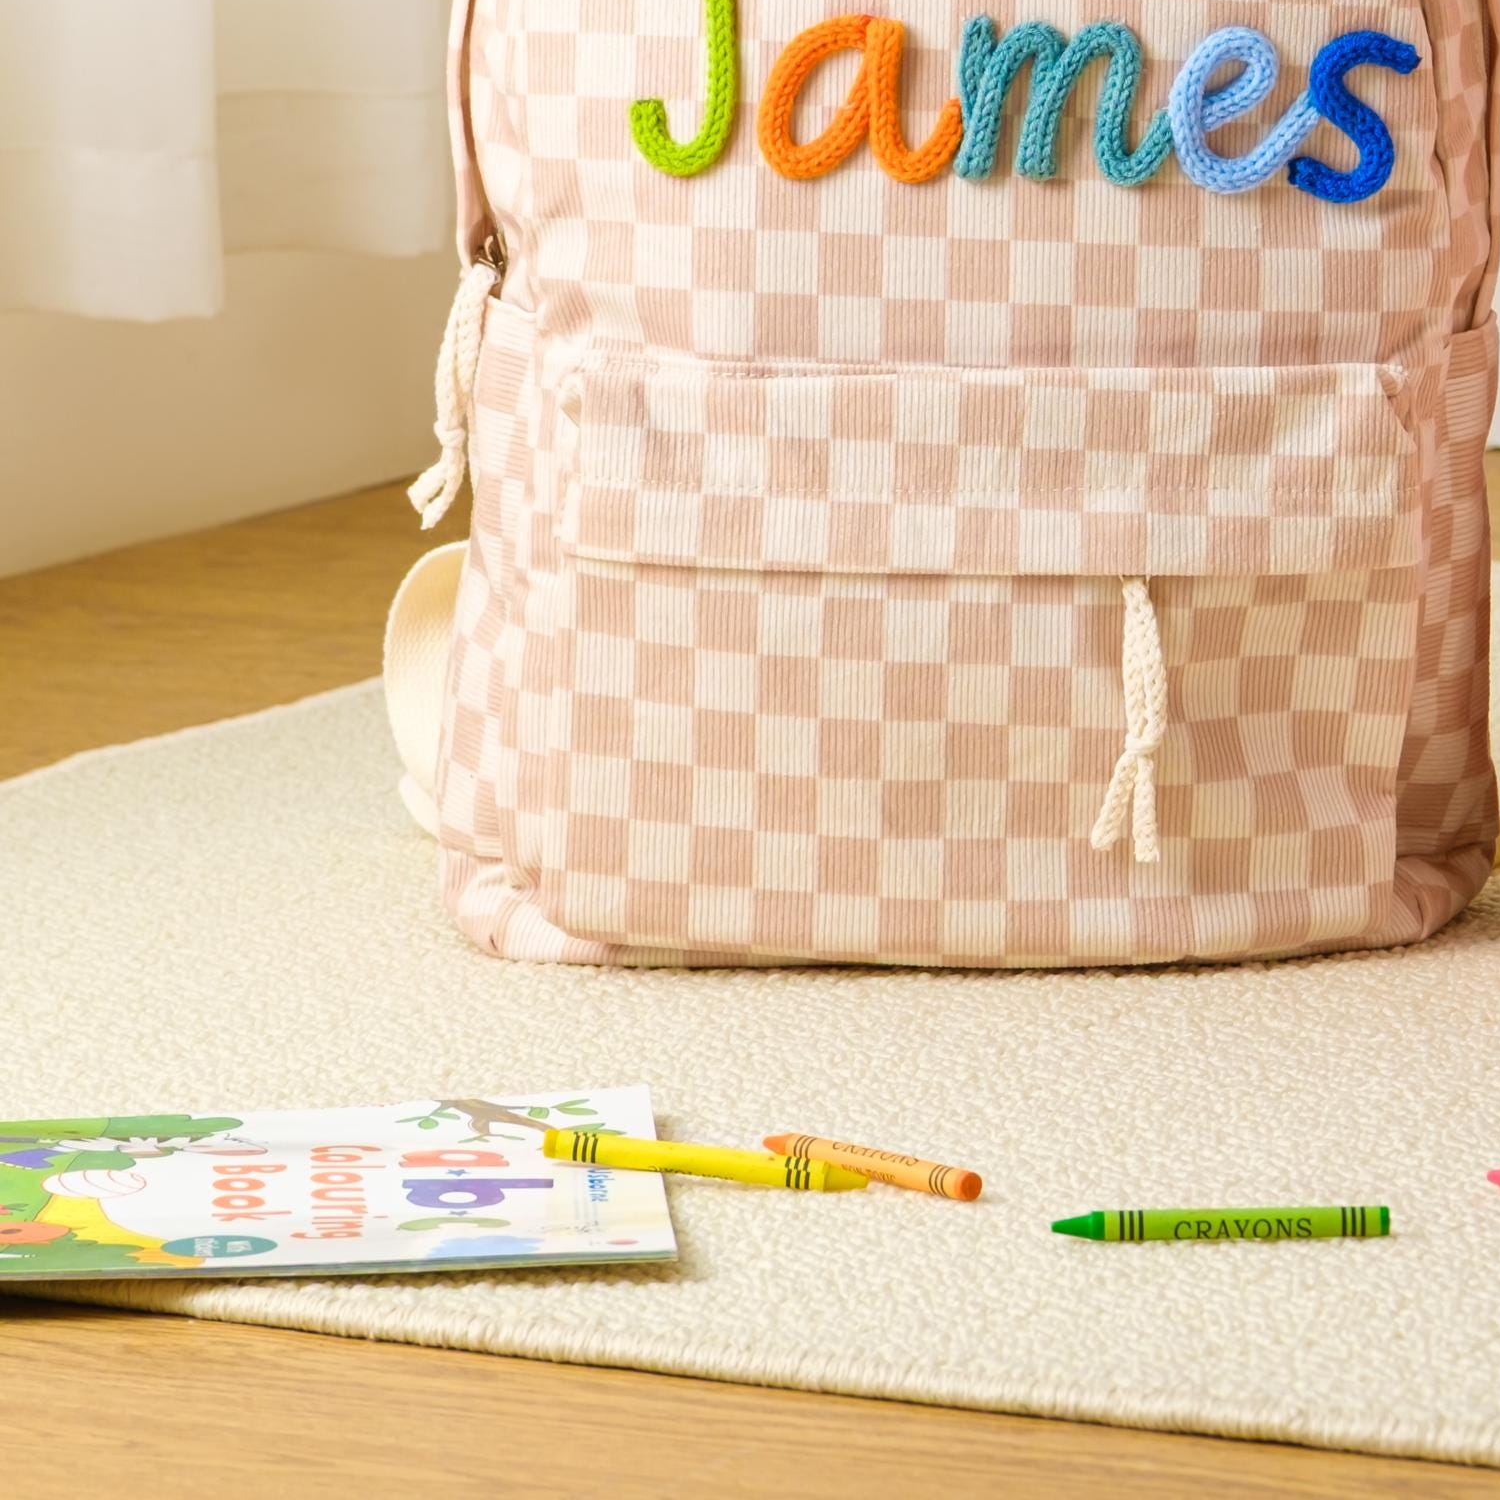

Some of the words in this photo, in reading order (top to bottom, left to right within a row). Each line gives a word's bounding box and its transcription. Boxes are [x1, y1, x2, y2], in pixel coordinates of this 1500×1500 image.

[211, 1164, 292, 1221] Book
[290, 1145, 389, 1240] Colouring
[1174, 1217, 1313, 1240] CRAYONS
